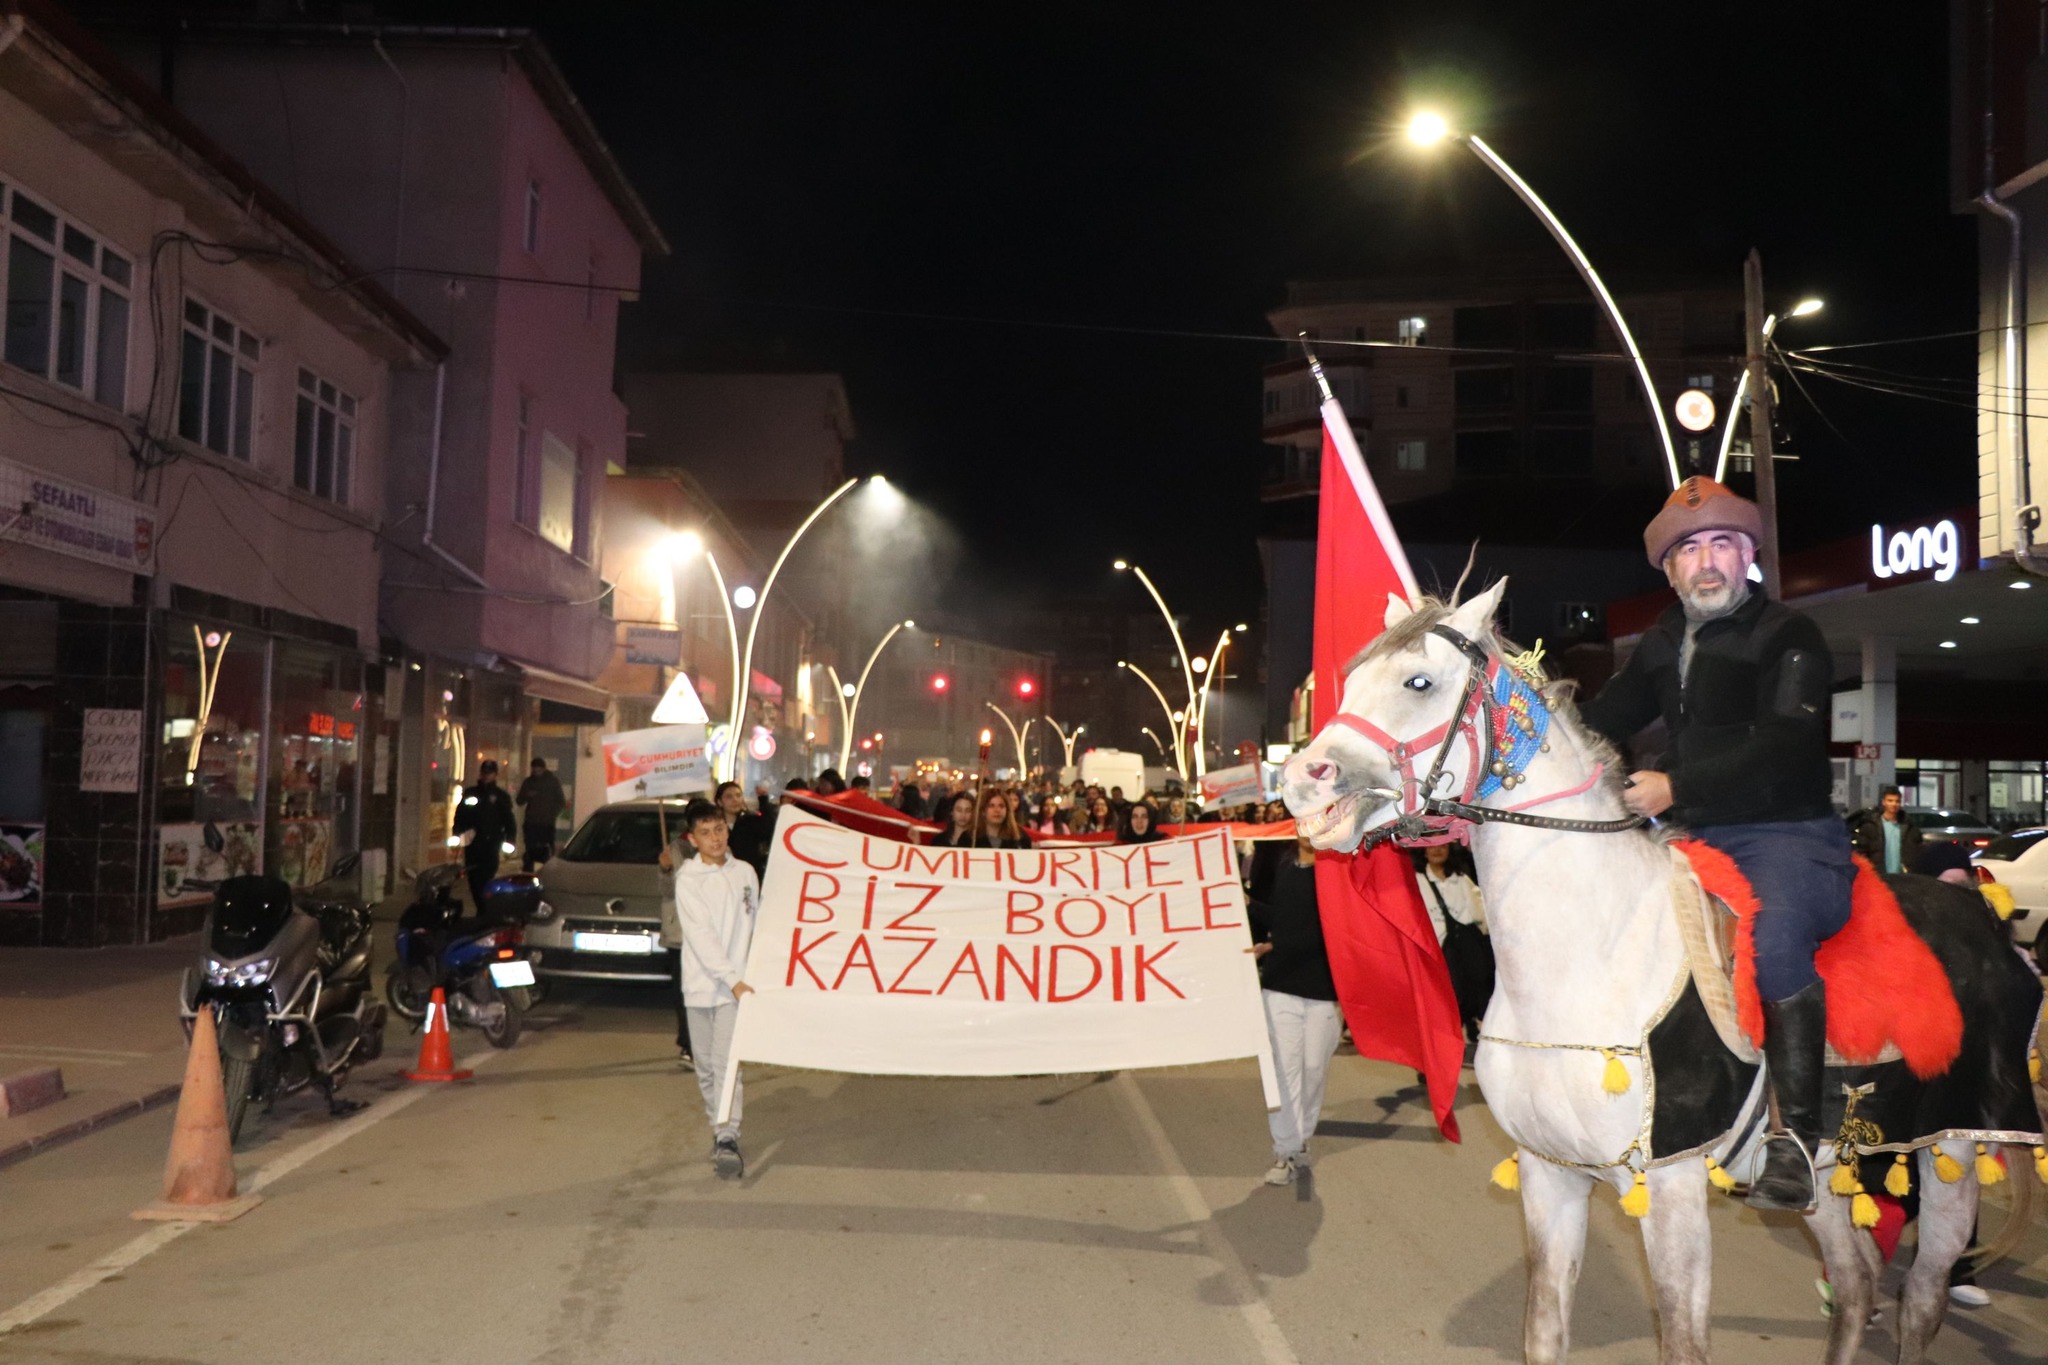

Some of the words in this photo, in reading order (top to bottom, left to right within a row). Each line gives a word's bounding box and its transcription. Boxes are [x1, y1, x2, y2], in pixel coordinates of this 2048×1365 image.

[1872, 519, 1957, 582] Long
[1857, 746, 1878, 759] LPG
[797, 871, 945, 931] BİZ
[1005, 882, 1242, 939] BÖYLE
[785, 927, 1185, 1003] KAZANDIK
